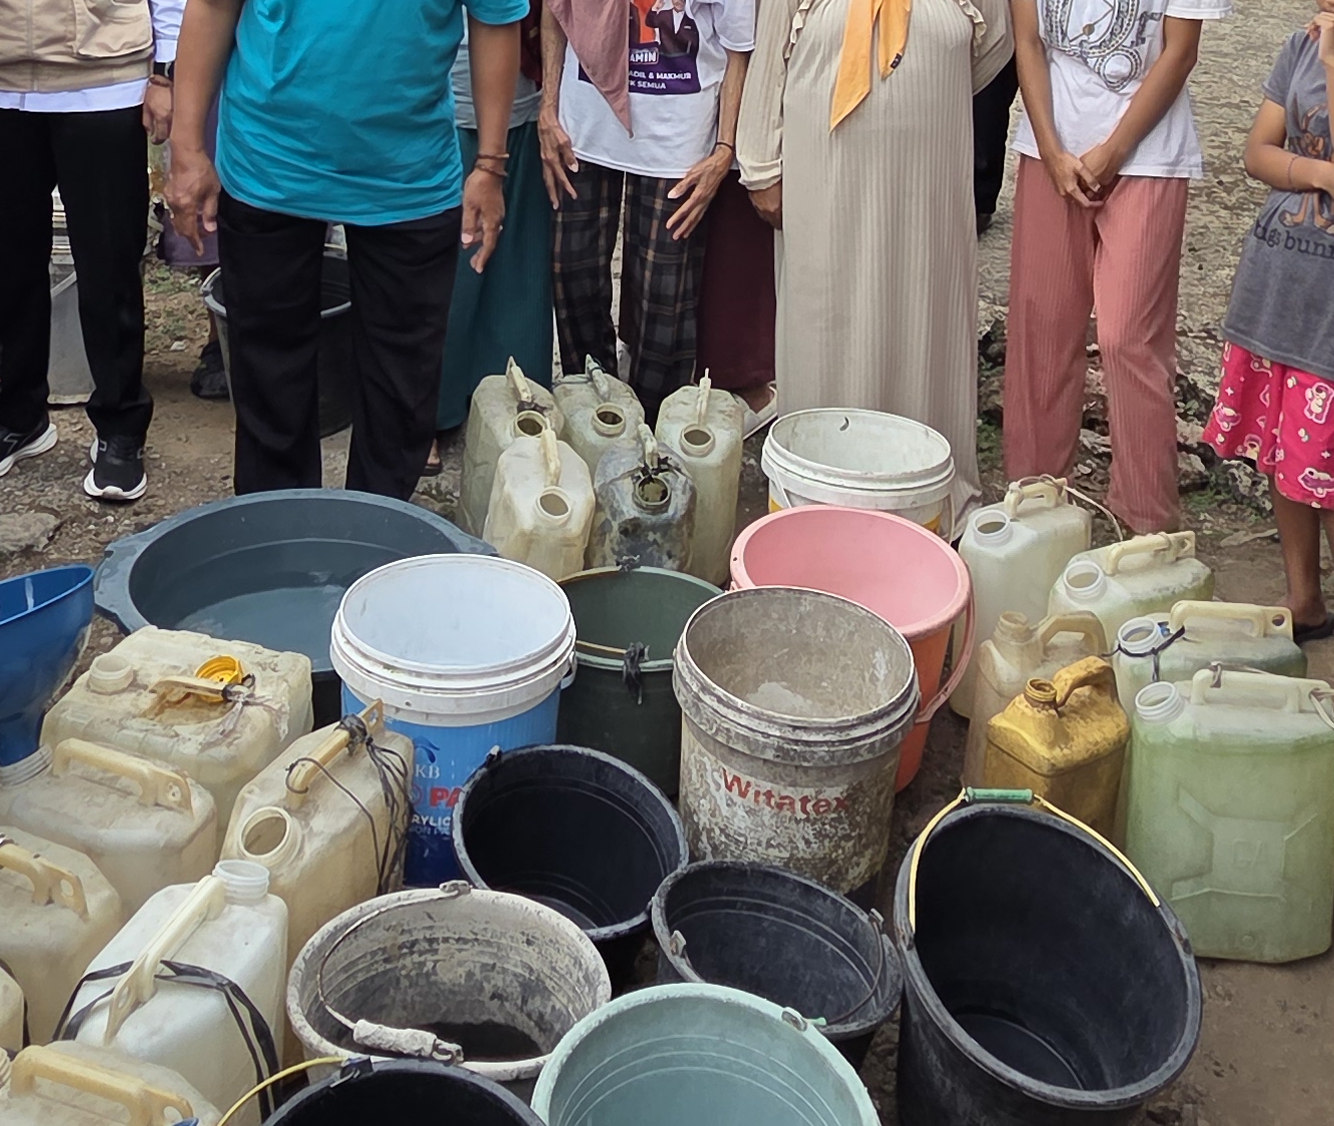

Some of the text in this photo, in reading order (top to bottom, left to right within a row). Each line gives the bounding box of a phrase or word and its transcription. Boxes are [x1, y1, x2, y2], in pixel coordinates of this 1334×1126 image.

[648, 71, 655, 79] &
[656, 71, 692, 80] MAKMUR
[637, 80, 667, 89] SEMUA
[721, 767, 848, 816] Witatex
[411, 814, 452, 827] RYLIC
